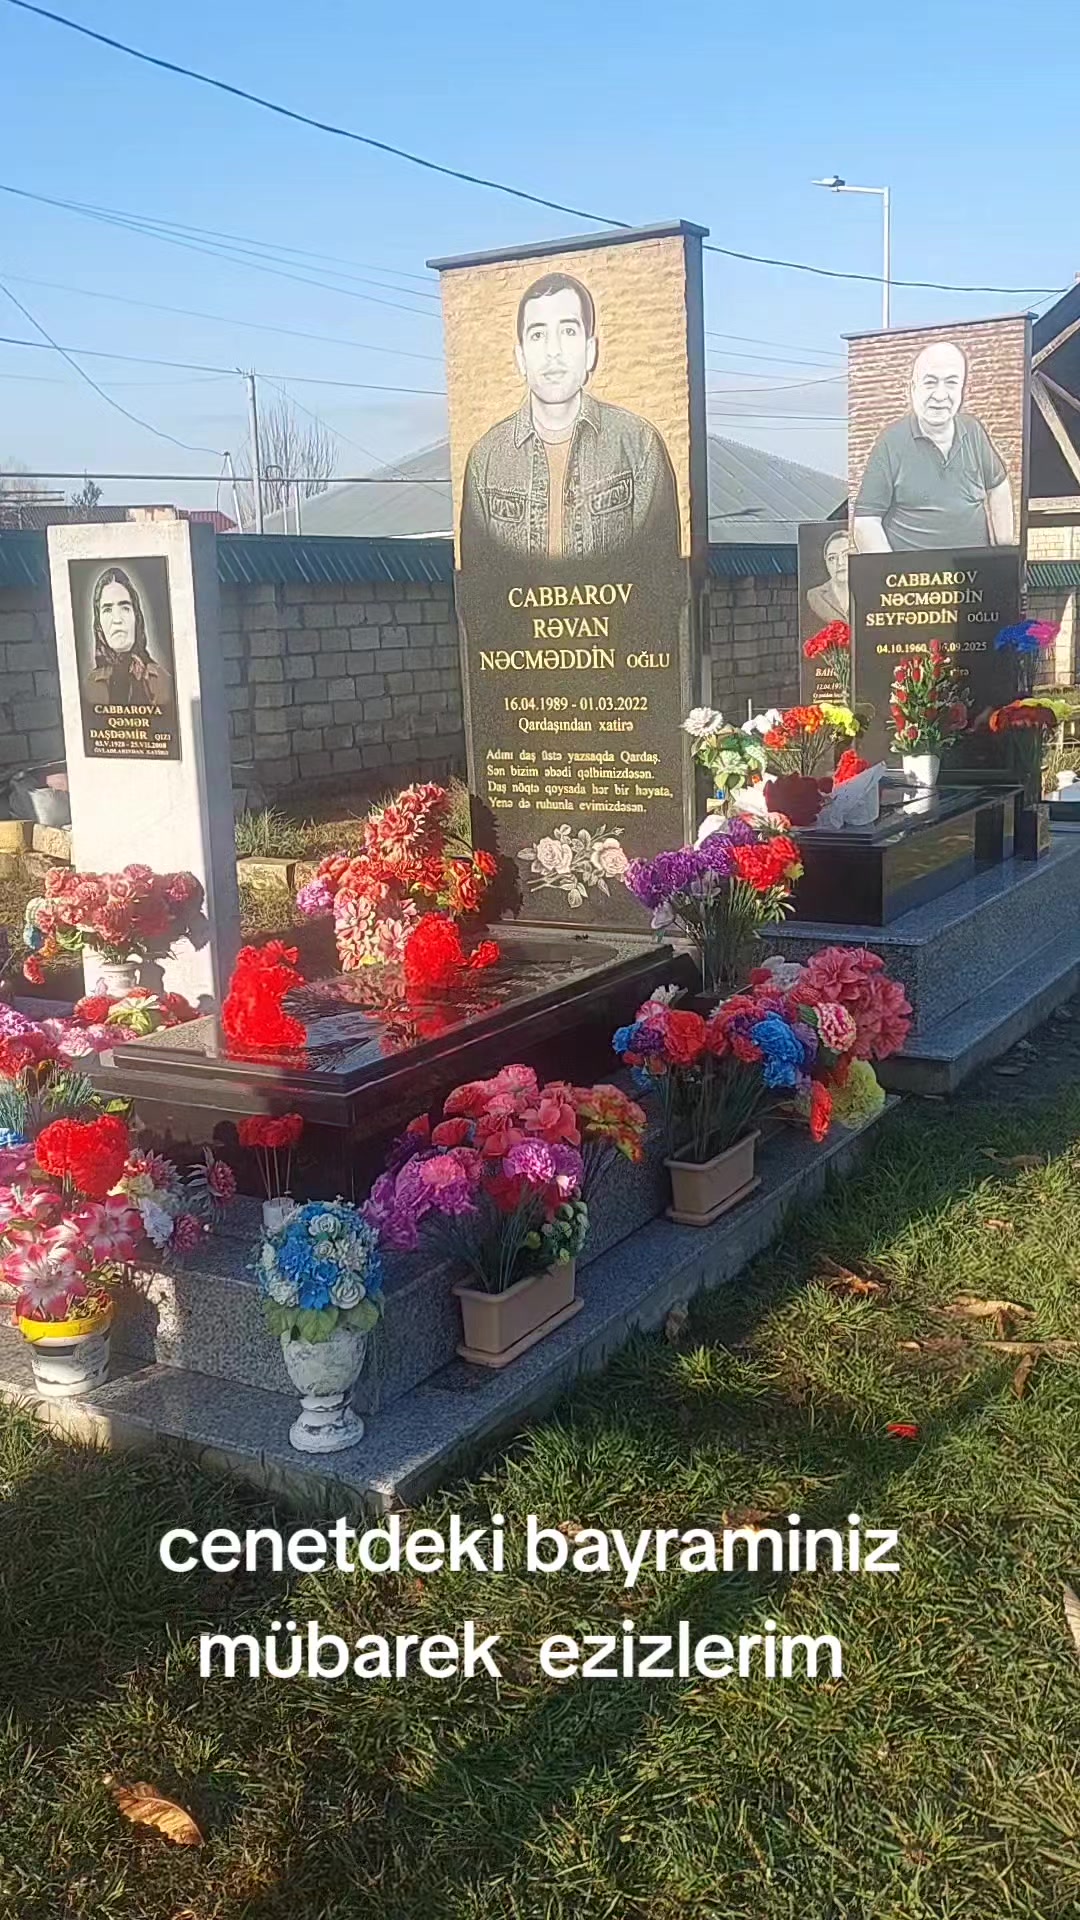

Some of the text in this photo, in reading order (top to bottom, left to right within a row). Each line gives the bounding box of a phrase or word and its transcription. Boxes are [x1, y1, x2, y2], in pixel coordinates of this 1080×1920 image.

[885, 571, 978, 588] CABBAROV
[508, 584, 634, 608] CABBAROV
[880, 588, 984, 607] NƏCMƏDDİN
[865, 608, 999, 626] SEYFƏDDİN OĞLU
[533, 617, 609, 638] RƏVAN
[876, 643, 927, 654] 04.10.1960
[480, 645, 670, 670] NƏCMƏDDİN OĞLU
[94, 704, 162, 715] CABBAROVA
[504, 697, 568, 711] 16.04.1989
[580, 696, 648, 711] 01.03.2022
[108, 717, 150, 728] QƏMƏR
[518, 717, 634, 734] Qardaşından xatirə
[89, 729, 148, 741] DAŞDƏMİR
[486, 749, 661, 765] Adını daş üstə yazsaqda Qardaş.
[487, 765, 506, 776] Sən
[510, 766, 539, 777] bizim
[544, 766, 572, 778] əbədi
[487, 781, 507, 793] Daş
[545, 783, 586, 796] qoysada
[592, 784, 609, 795] hər
[614, 784, 629, 796] bir
[488, 796, 647, 813] Yenə də ruhunla evimizdəsən.
